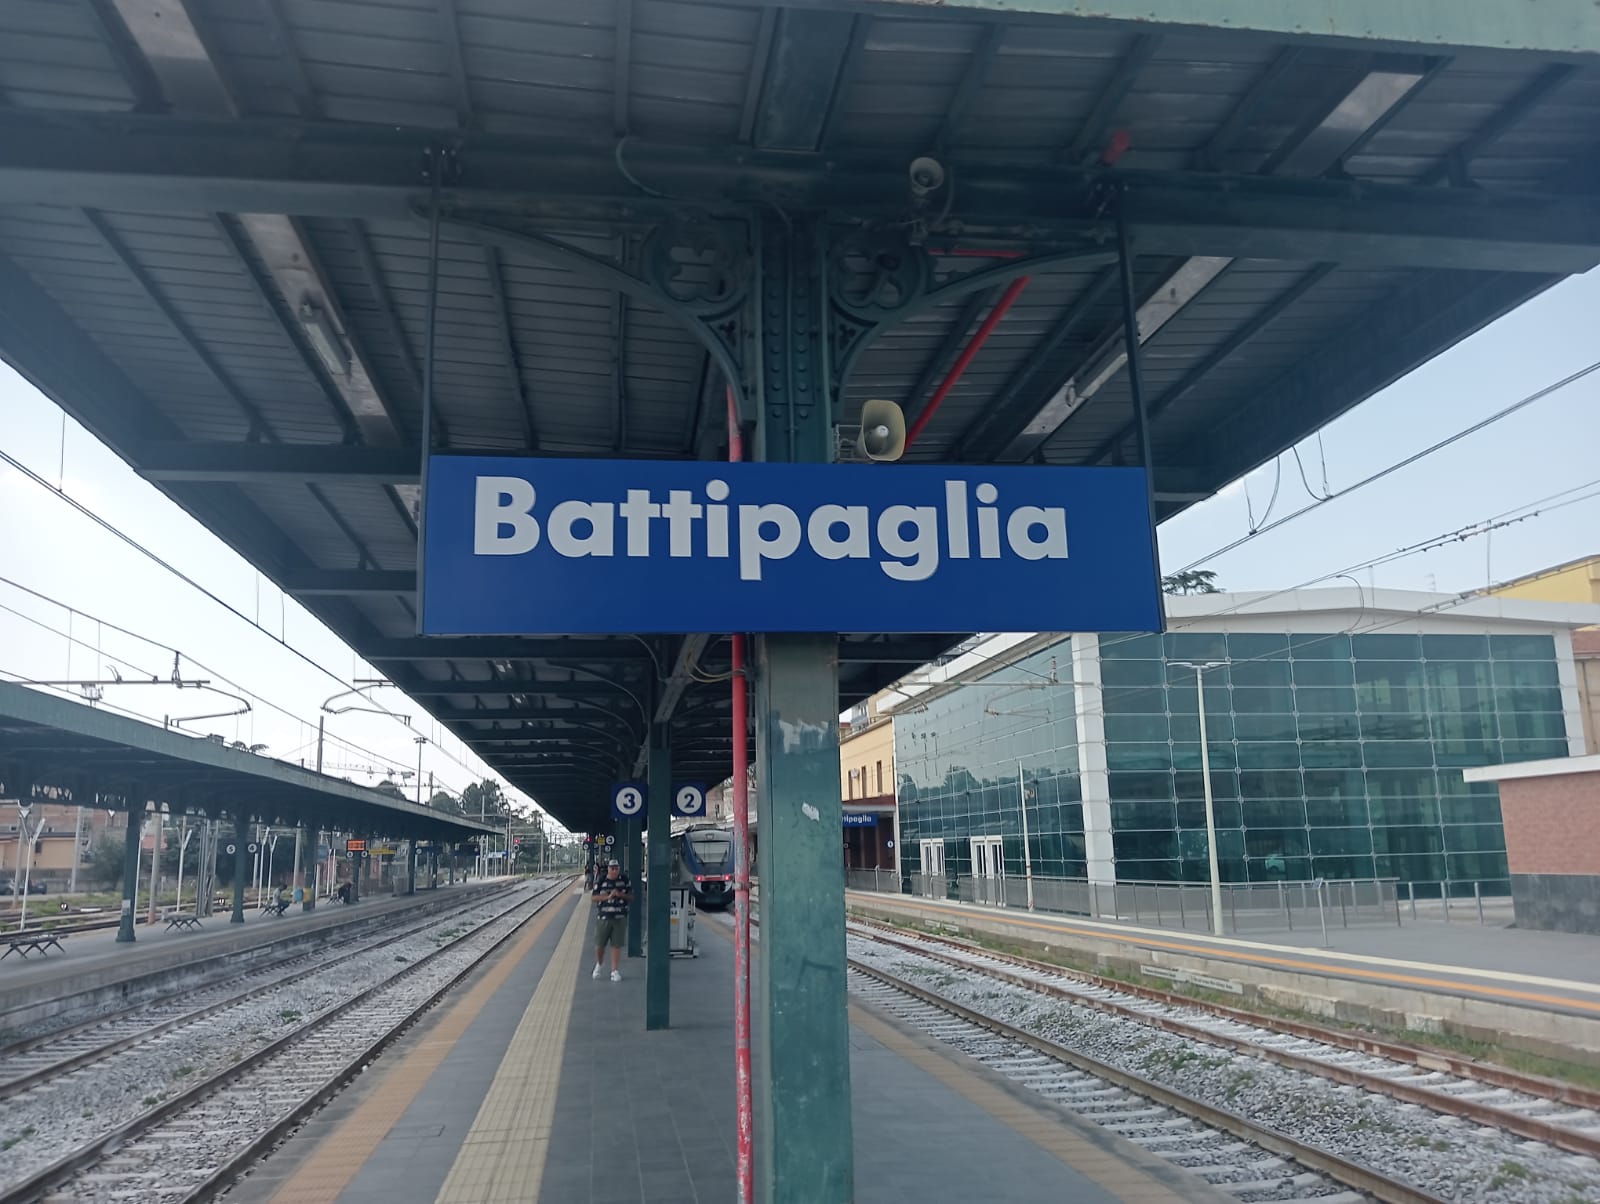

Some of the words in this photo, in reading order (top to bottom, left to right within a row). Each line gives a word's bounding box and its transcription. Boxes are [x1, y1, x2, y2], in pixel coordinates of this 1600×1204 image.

[474, 475, 1069, 581] Battipaglia
[623, 793, 635, 809] 3
[684, 793, 695, 808] 2
